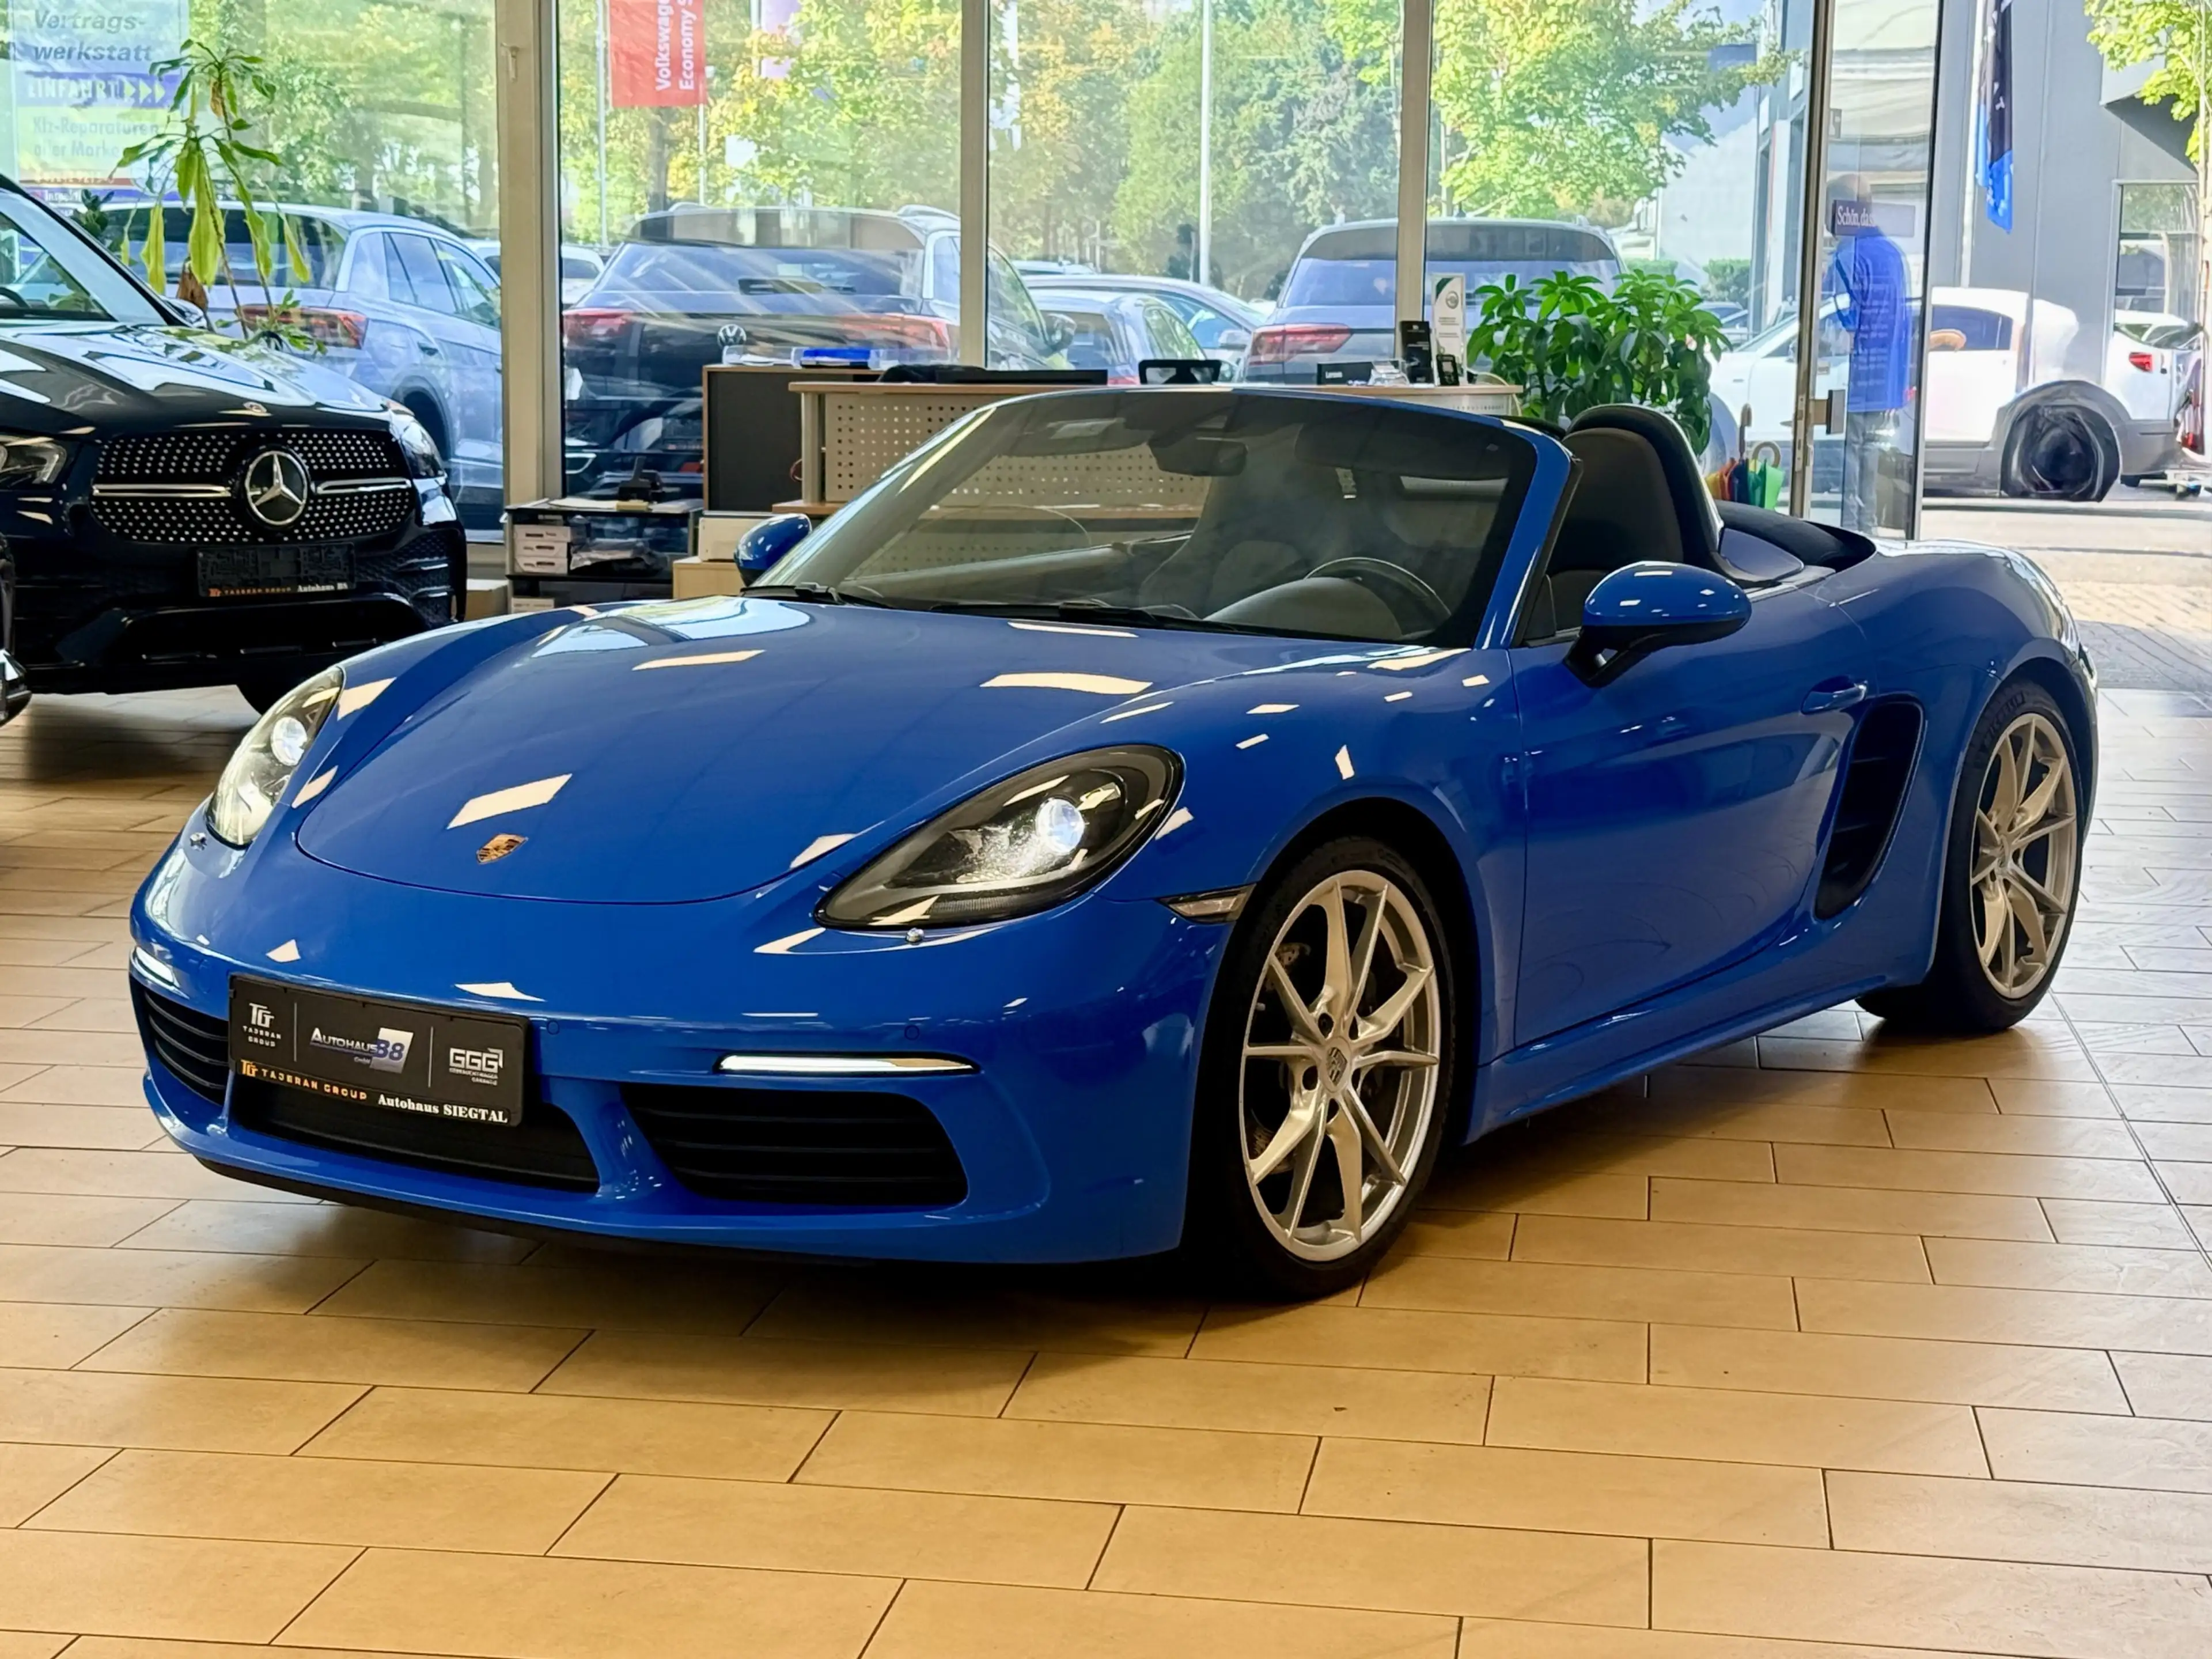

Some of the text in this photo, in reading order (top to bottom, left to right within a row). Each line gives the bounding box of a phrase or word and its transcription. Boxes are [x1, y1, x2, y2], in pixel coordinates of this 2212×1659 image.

[33, 9, 147, 35] Vertrags-
[33, 40, 152, 62] werkstatt
[679, 7, 698, 90] Economy
[248, 1036, 276, 1047] GROUP
[262, 1069, 318, 1090] TAJERAN
[324, 1084, 368, 1100] GROUP
[378, 1093, 440, 1115] Autohaus
[442, 1104, 508, 1123] SIEGTAL
